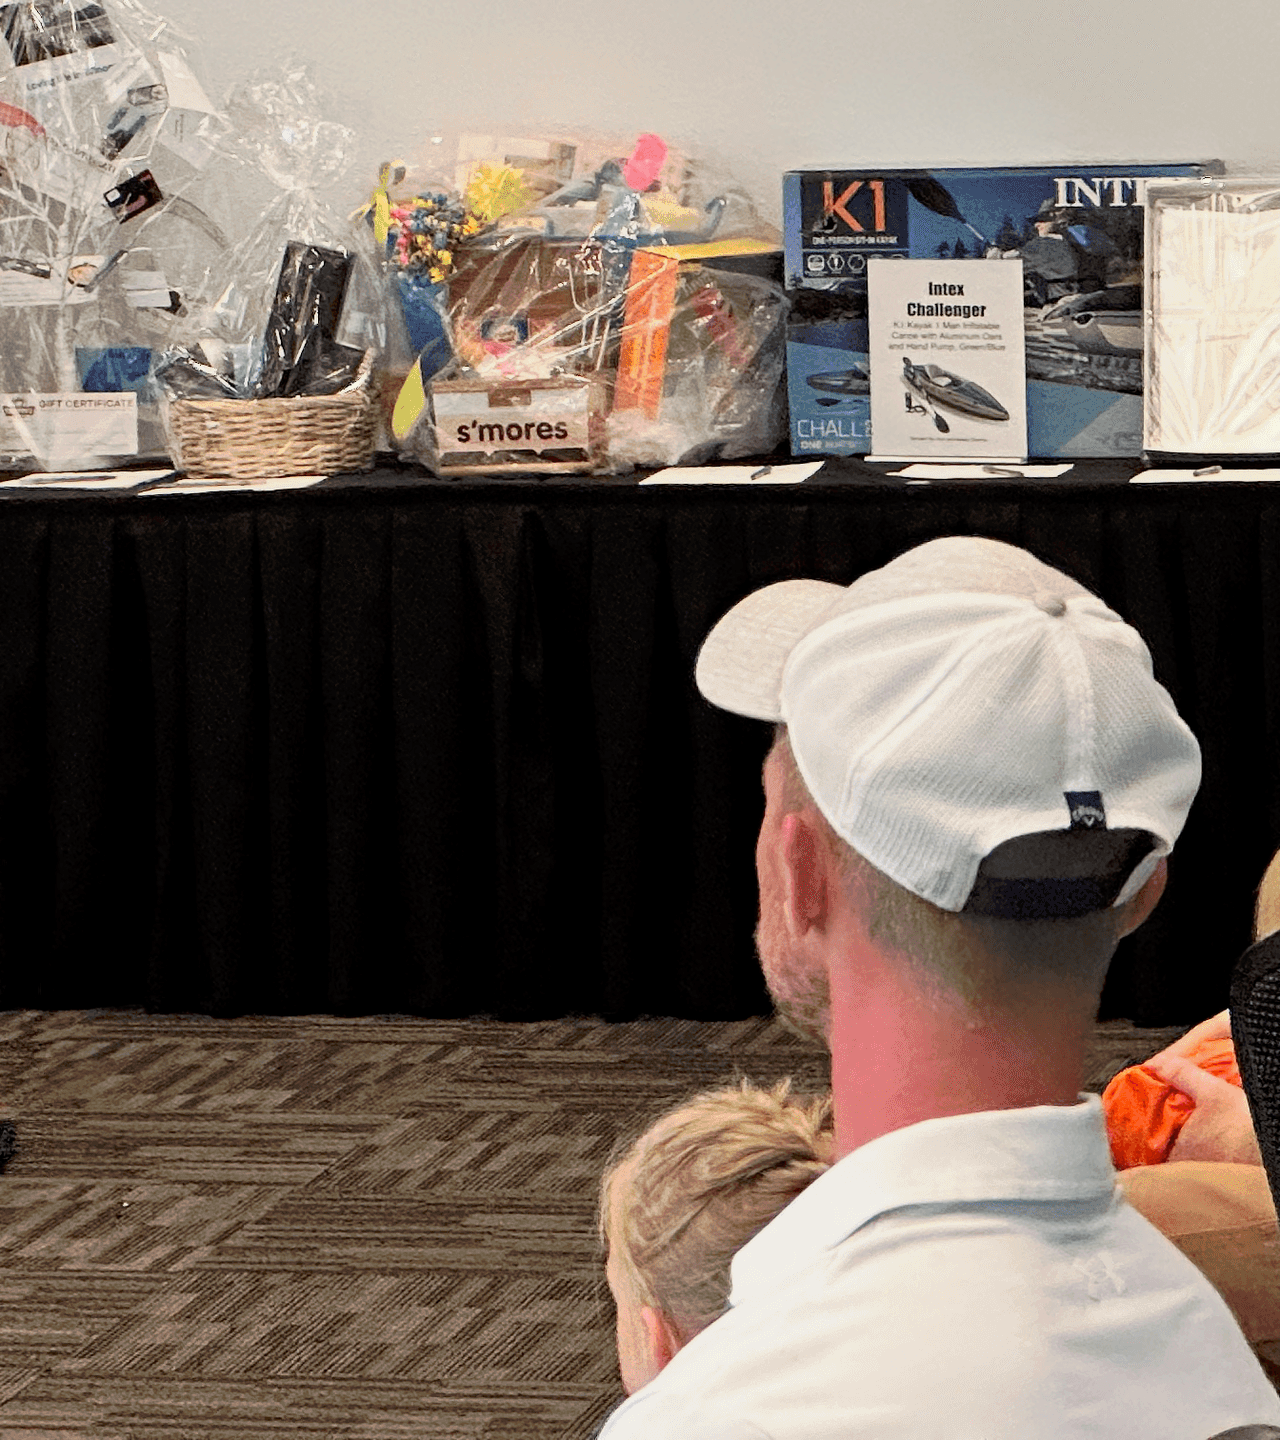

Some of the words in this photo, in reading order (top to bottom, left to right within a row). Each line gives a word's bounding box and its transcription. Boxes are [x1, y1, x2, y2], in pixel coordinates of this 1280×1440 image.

[928, 282, 964, 296] Intex
[906, 302, 987, 319] Challenger
[39, 399, 62, 409] GIFT
[65, 399, 134, 408] CERTIFICATE
[457, 420, 568, 443] s'mores
